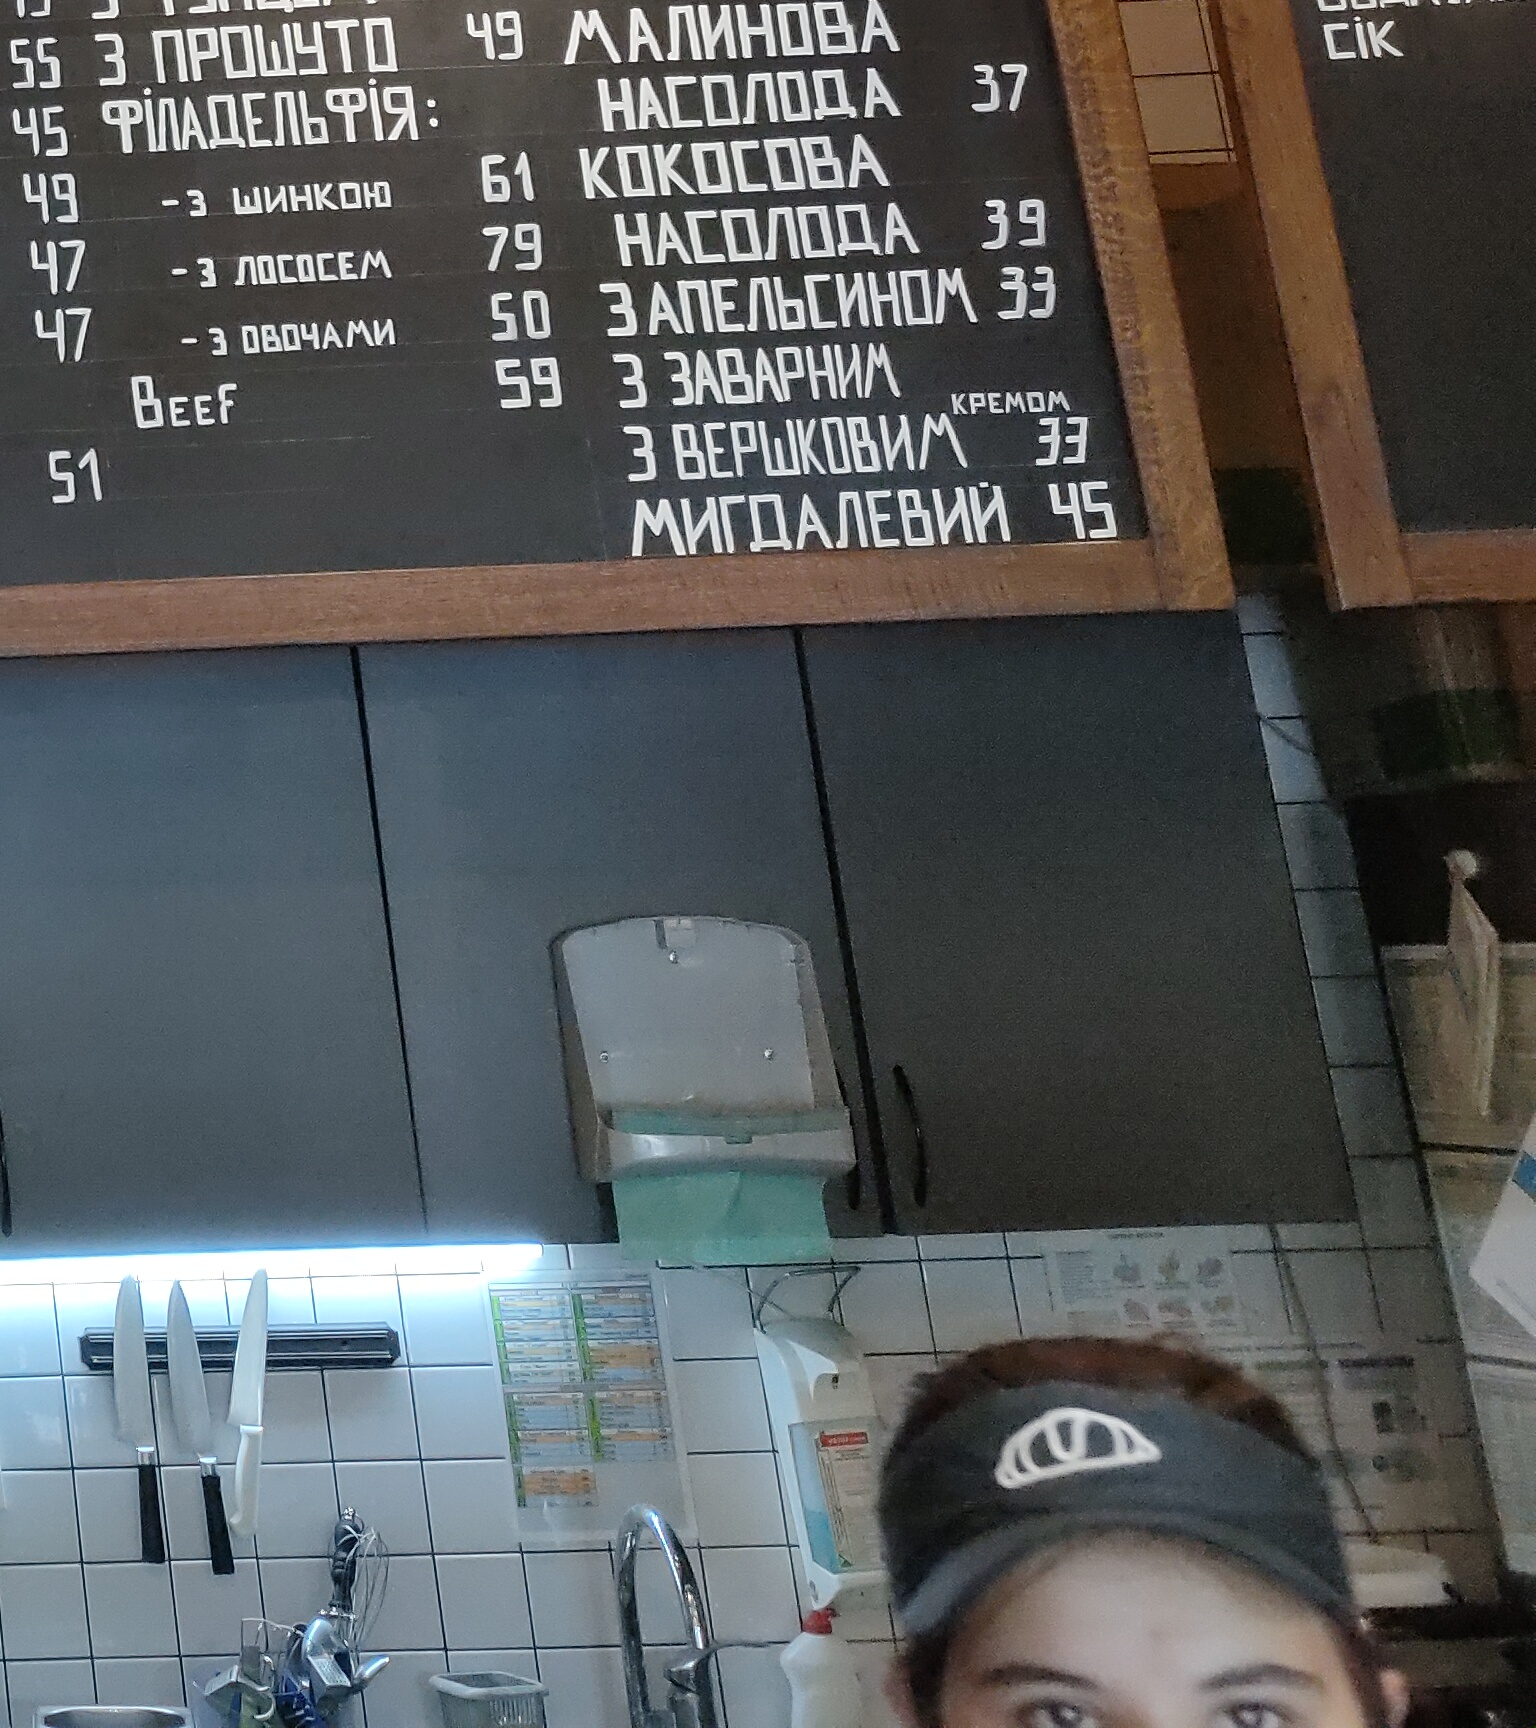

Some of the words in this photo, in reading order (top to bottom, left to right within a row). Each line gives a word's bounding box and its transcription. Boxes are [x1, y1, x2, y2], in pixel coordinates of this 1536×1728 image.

[9, 36, 62, 89] 55
[150, 16, 399, 86] ПРОШУТО
[466, 10, 524, 61] 49
[1322, 15, 1405, 60] СІК
[596, 67, 902, 133] НАСОЛОДА
[971, 63, 1029, 113] 37
[12, 105, 69, 157] 45
[231, 181, 392, 215] ШИНКОЮ
[480, 151, 535, 203] 61
[578, 133, 891, 200] КОКОСОВА
[22, 173, 79, 225] 49
[233, 249, 393, 286] ЛОСОСЕМ
[481, 222, 543, 272] 79
[613, 202, 921, 267] НАСОЛОДА
[981, 198, 1047, 250] 39
[30, 239, 86, 296] 47
[241, 318, 397, 355] ОВОЧАМИ
[490, 289, 552, 342] 50
[648, 267, 979, 336] АПЕЛЬСИНОМ
[997, 265, 1057, 320] 33
[34, 307, 93, 364] 47
[494, 356, 563, 409] 59
[663, 342, 901, 406] ЗАВАРНИМ
[48, 447, 103, 504] 51
[671, 412, 968, 481] ВЕРШКОВИМ
[1034, 416, 1090, 467] 33
[631, 481, 1012, 557] МИГДАЛЕВИЙ
[1047, 480, 1118, 540] 45
